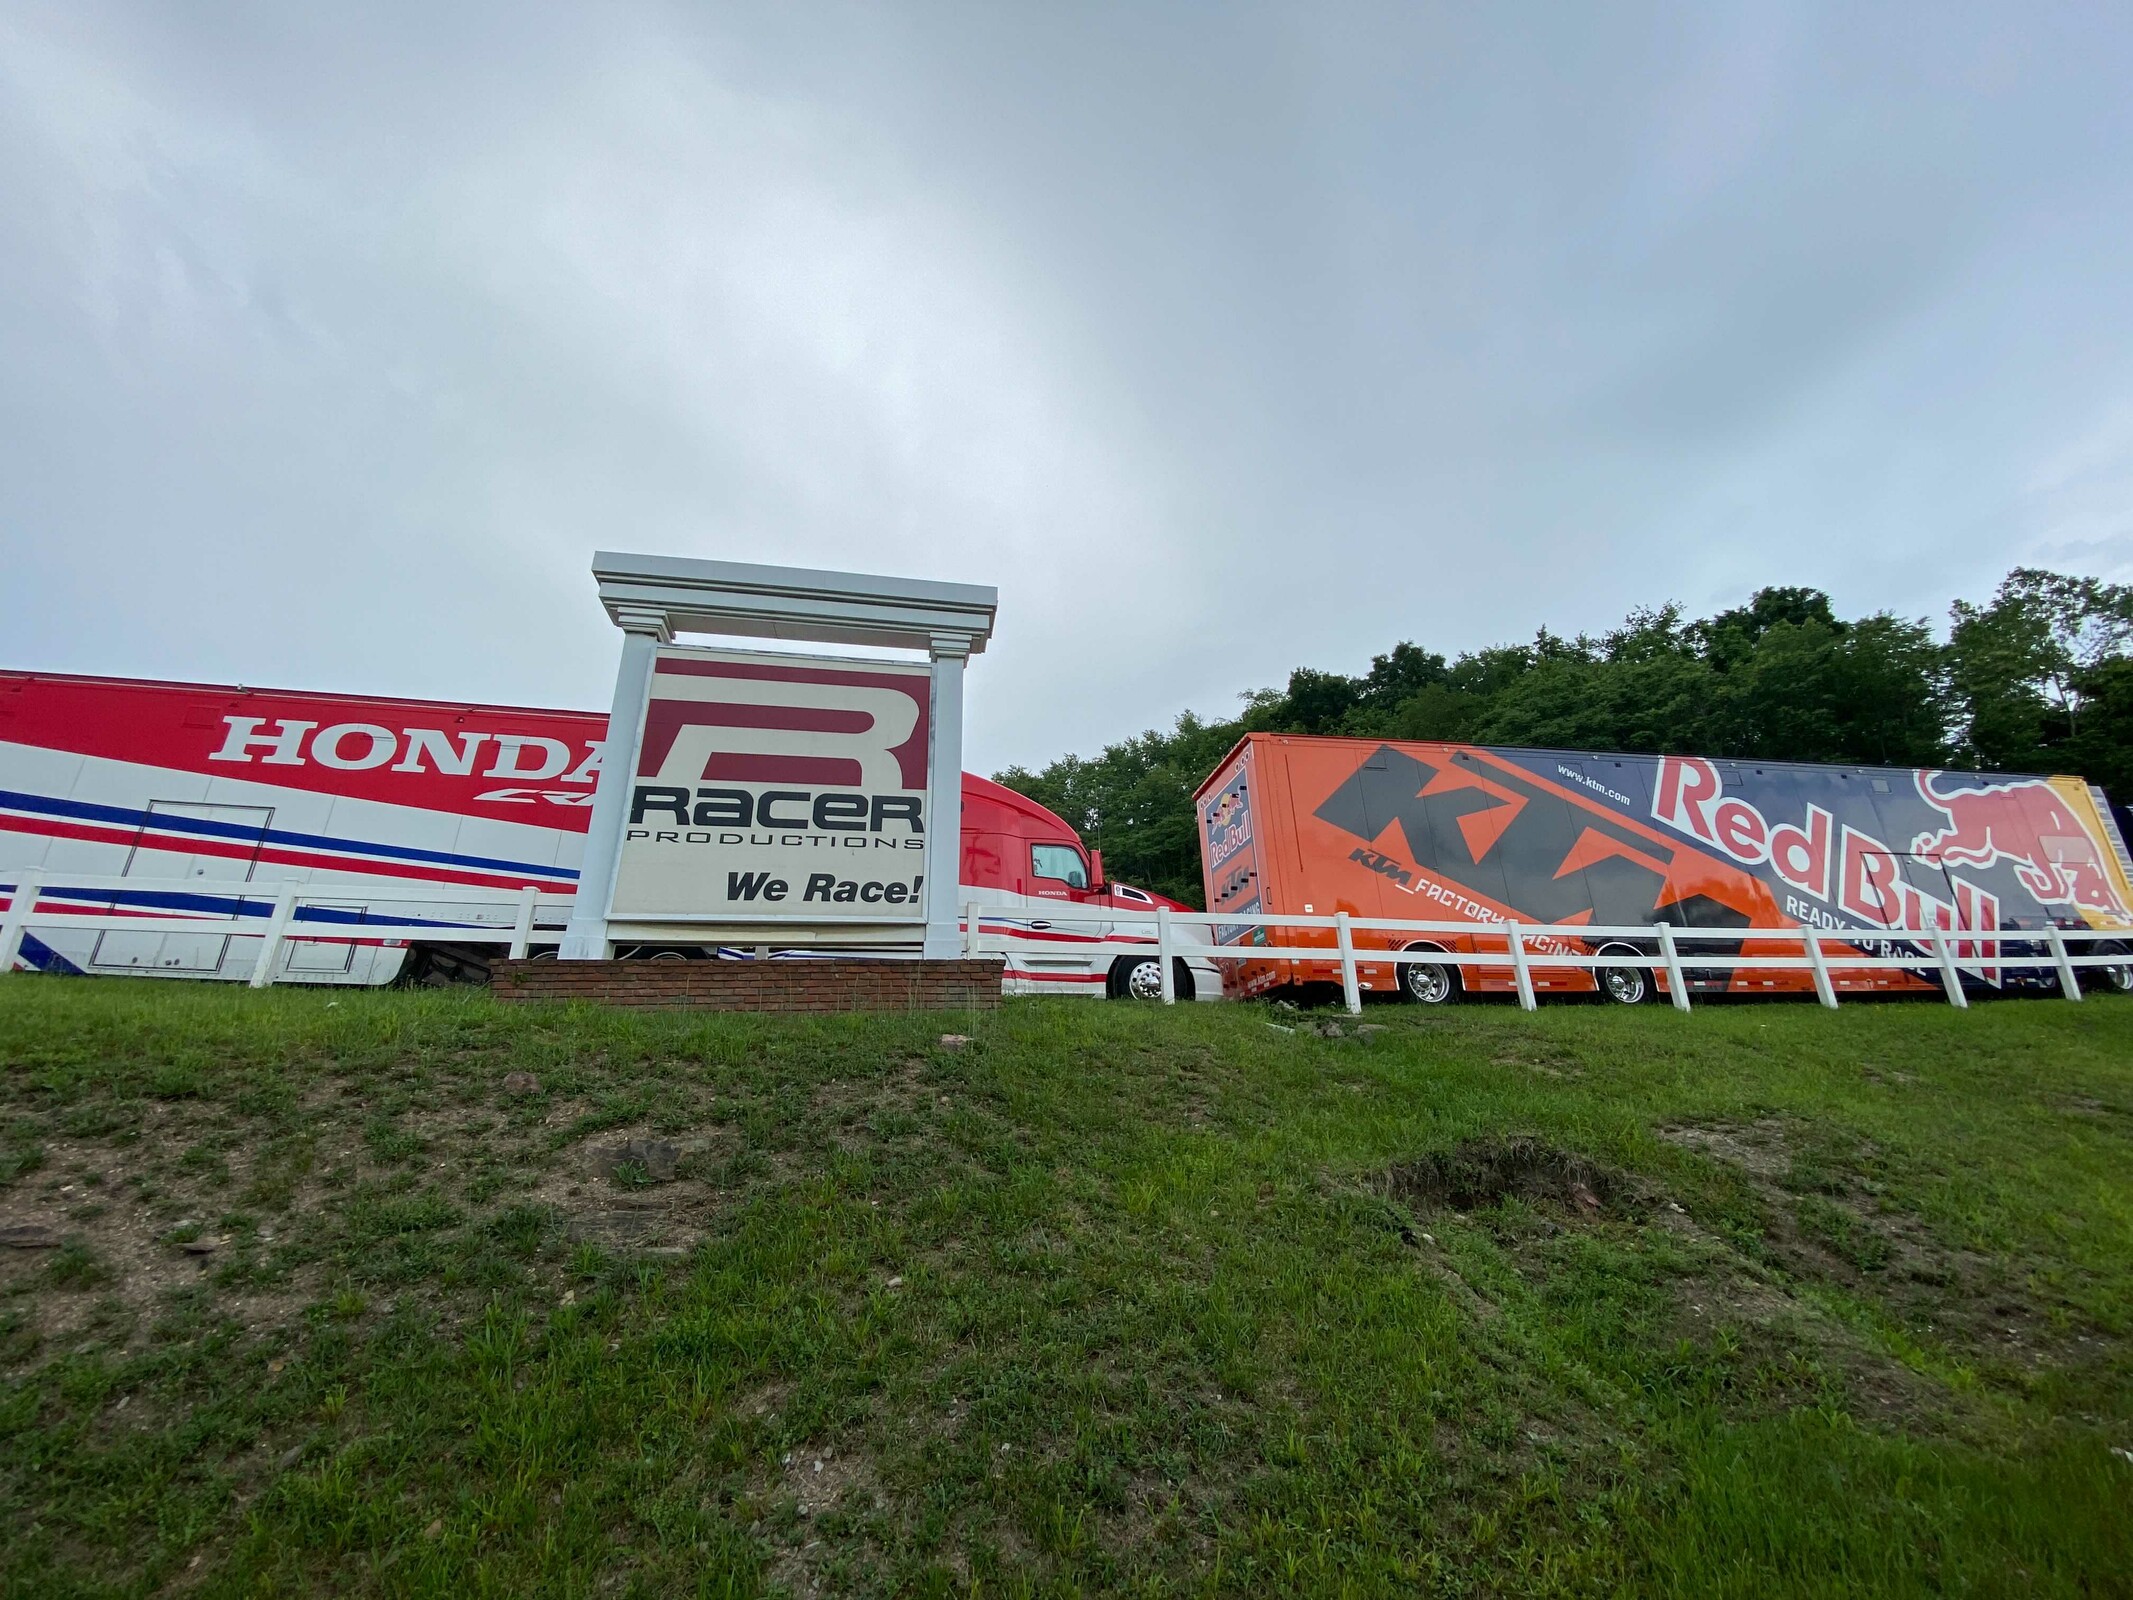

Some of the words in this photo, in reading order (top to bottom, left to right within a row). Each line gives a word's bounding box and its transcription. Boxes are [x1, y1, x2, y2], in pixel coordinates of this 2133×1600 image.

[1557, 765, 1631, 806] www.ktm.com
[626, 830, 925, 850] PRODUCTIONS
[1209, 829, 1231, 868] Red
[1229, 809, 1252, 853] Bull
[727, 872, 789, 901] We
[803, 873, 924, 903] Race!
[1651, 755, 1832, 902] Red
[1838, 824, 2001, 989] Bull
[1786, 894, 1846, 930] READY
